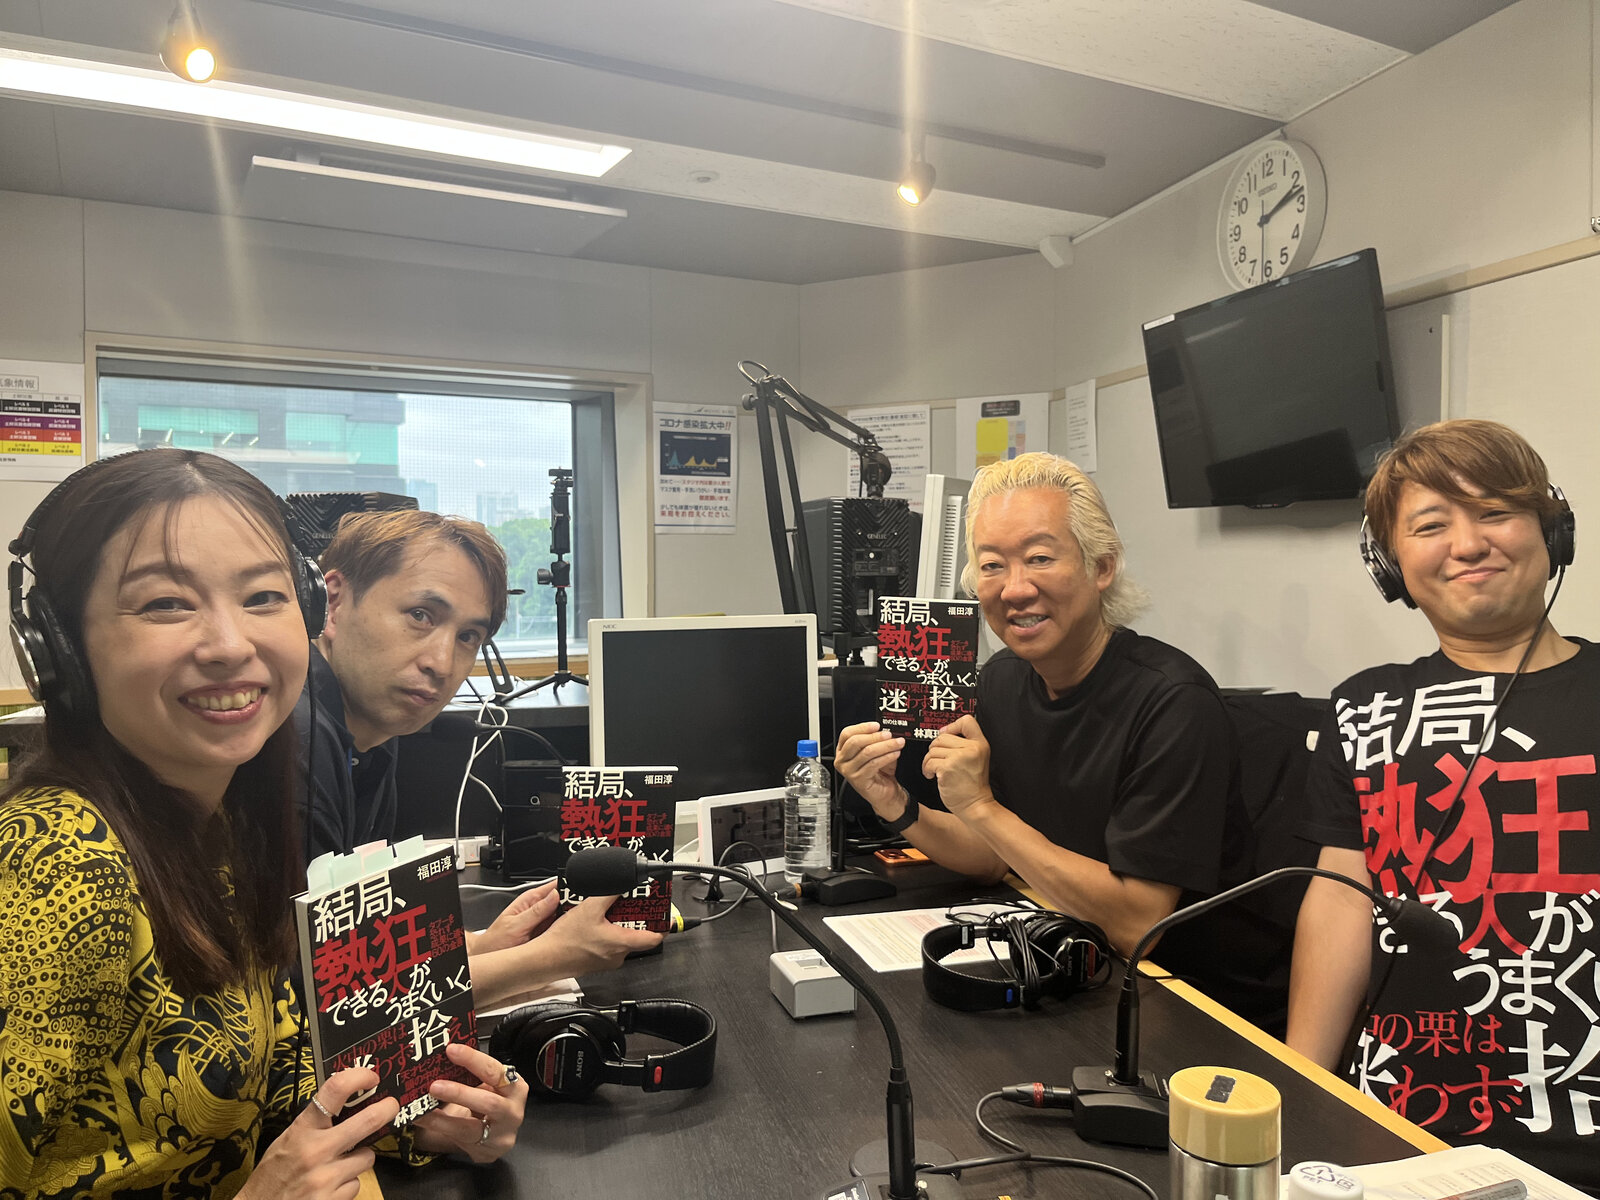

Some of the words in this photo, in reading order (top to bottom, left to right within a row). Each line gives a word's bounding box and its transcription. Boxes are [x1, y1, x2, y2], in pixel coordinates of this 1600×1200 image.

[1262, 158, 1274, 179] 12
[1282, 158, 1286, 176] 1
[1248, 174, 1257, 193] 11
[1291, 170, 1300, 189] 2
[1238, 197, 1248, 216] 10
[1297, 194, 1305, 213] 3
[1233, 225, 1241, 242] 9
[1291, 223, 1299, 240] 4
[1238, 246, 1247, 263] 8
[1280, 247, 1289, 265] 5
[1249, 259, 1257, 276] 7
[1264, 260, 1272, 278] 6
[659, 418, 732, 431] コロナ感染拡大中!!
[880, 599, 939, 626] 結局、
[948, 606, 974, 616] 福田淳
[877, 623, 952, 661] 熱狂
[916, 671, 976, 687] うまくいく。
[1336, 675, 1537, 772] 結局、
[564, 770, 634, 799] 結局、
[644, 775, 673, 785] 福田淳
[560, 798, 648, 841] 熱狂
[416, 854, 453, 881] 福田淳
[313, 870, 407, 944] 結局、
[313, 904, 432, 1012] 熱狂
[1452, 947, 1600, 1024] うまく
[385, 965, 473, 1026] うまくいく。
[575, 1050, 584, 1080] SONY
[1302, 1175, 1324, 1184] PET
